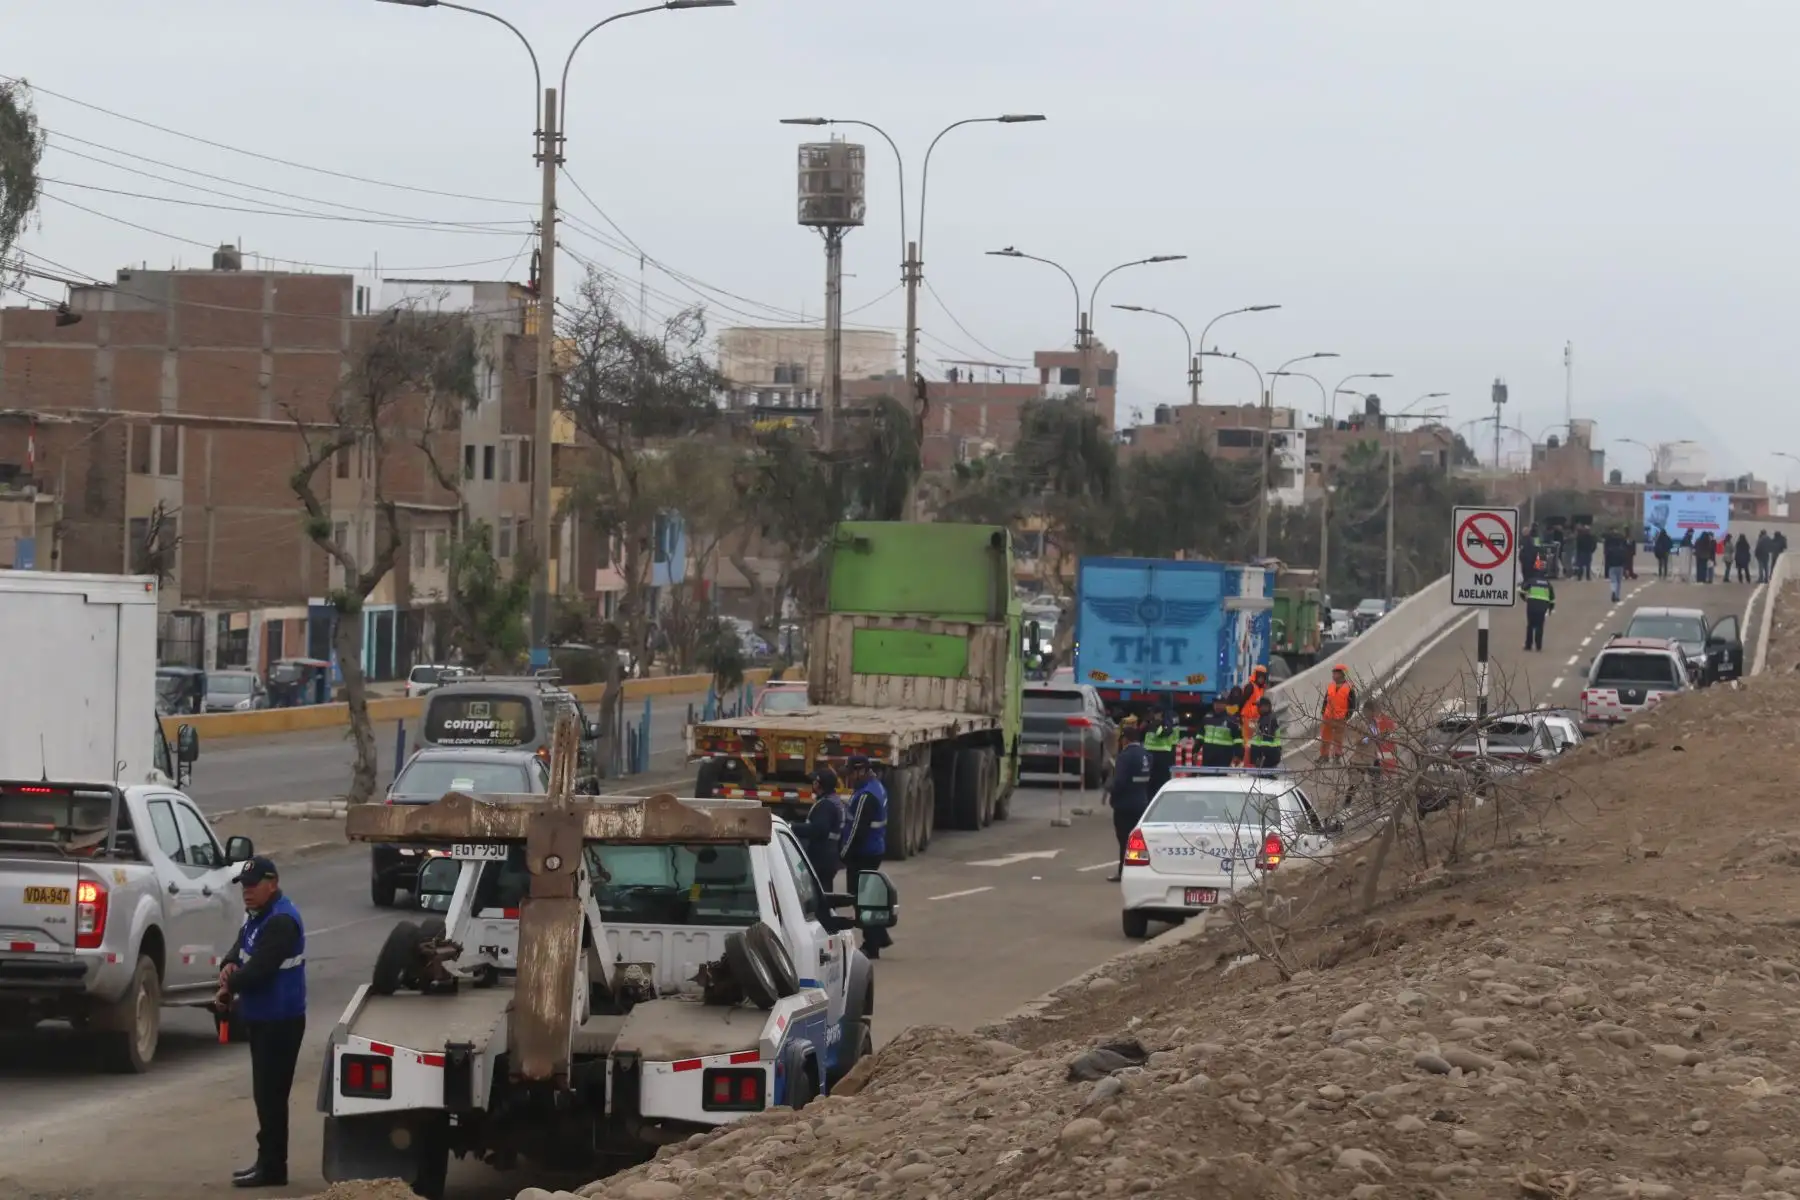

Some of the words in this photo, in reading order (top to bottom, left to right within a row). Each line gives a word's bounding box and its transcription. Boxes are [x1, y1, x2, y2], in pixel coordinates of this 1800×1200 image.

[1474, 573, 1493, 586] NO
[1458, 588, 1508, 600] ADELANTAR
[444, 719, 515, 733] compunet
[26, 886, 70, 902] VDA-947
